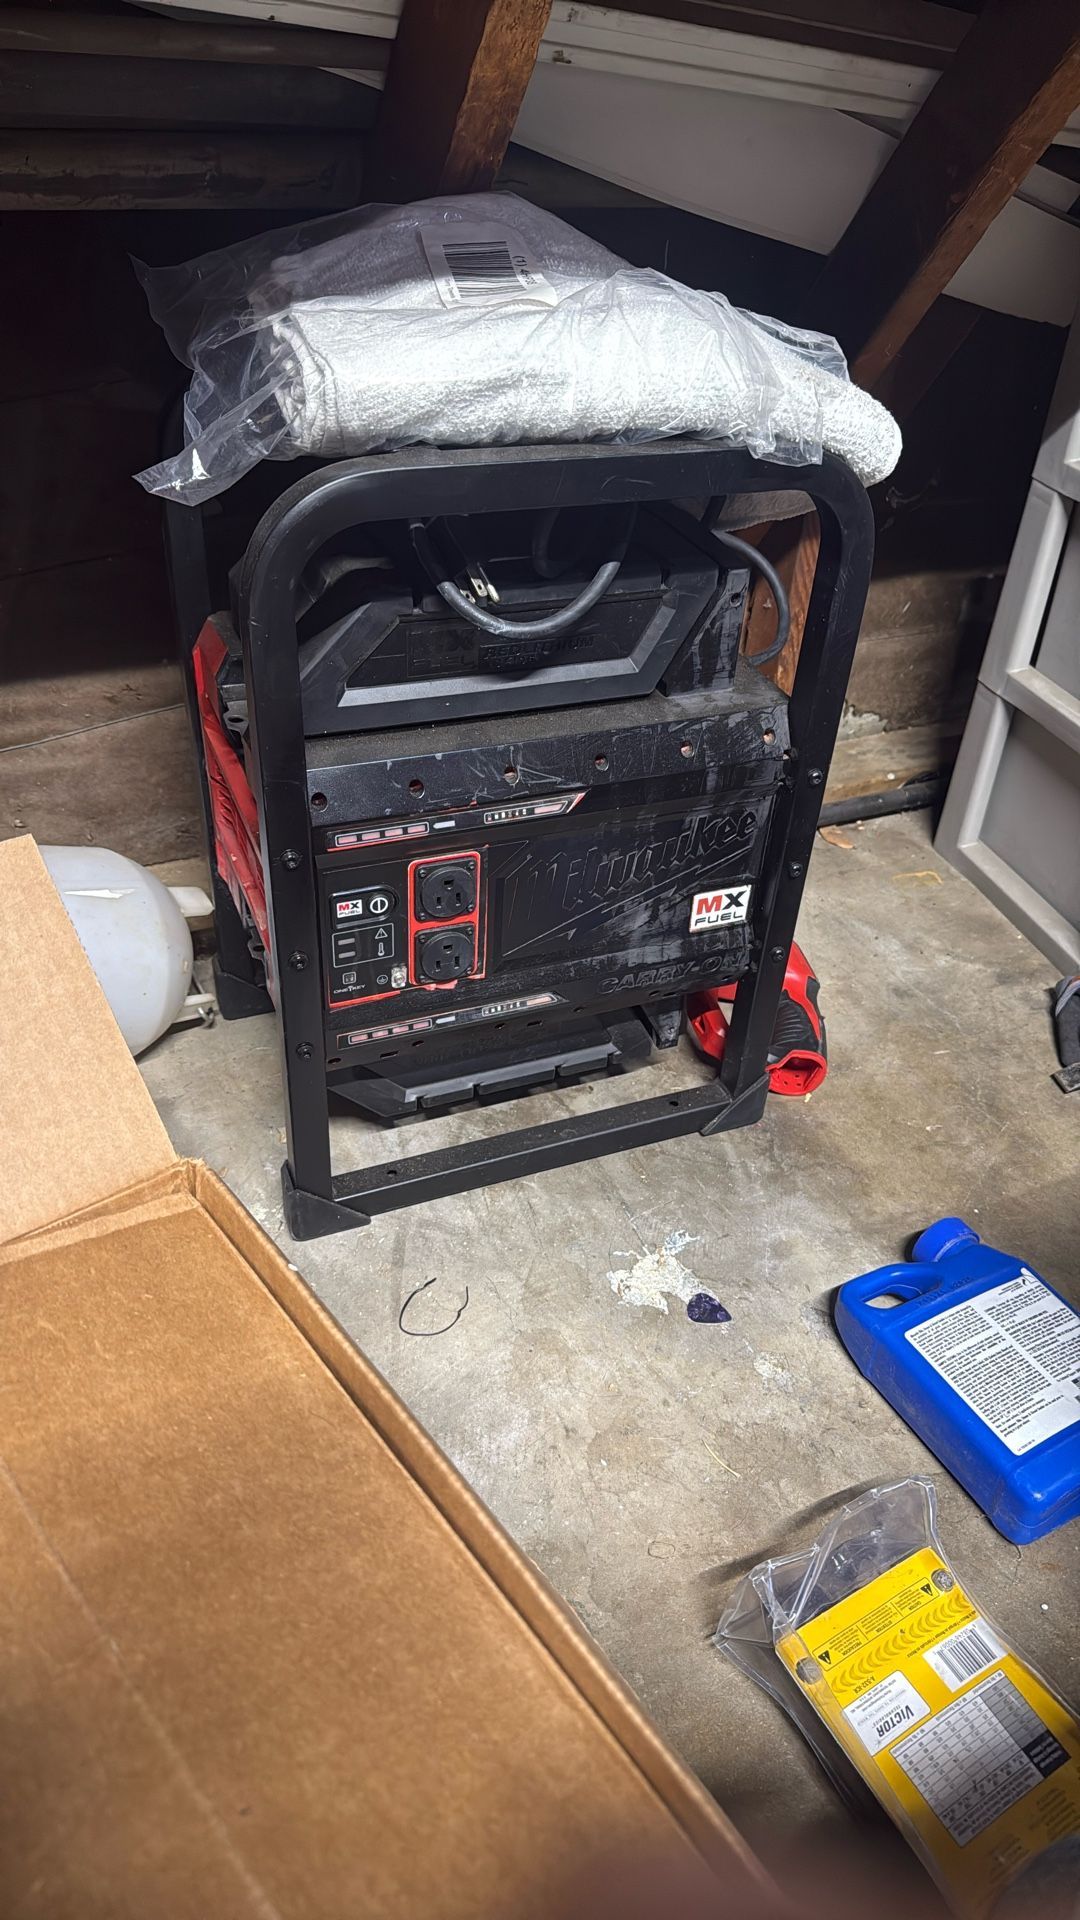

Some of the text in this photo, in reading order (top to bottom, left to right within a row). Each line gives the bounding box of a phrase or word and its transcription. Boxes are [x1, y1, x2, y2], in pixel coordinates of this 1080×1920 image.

[503, 807, 758, 929] Milwaukee
[338, 901, 360, 911] MX
[696, 890, 747, 915] MX
[694, 911, 744, 927] FUEL
[599, 952, 745, 994] CARRY-ON
[875, 1704, 915, 1738] VICTOR
